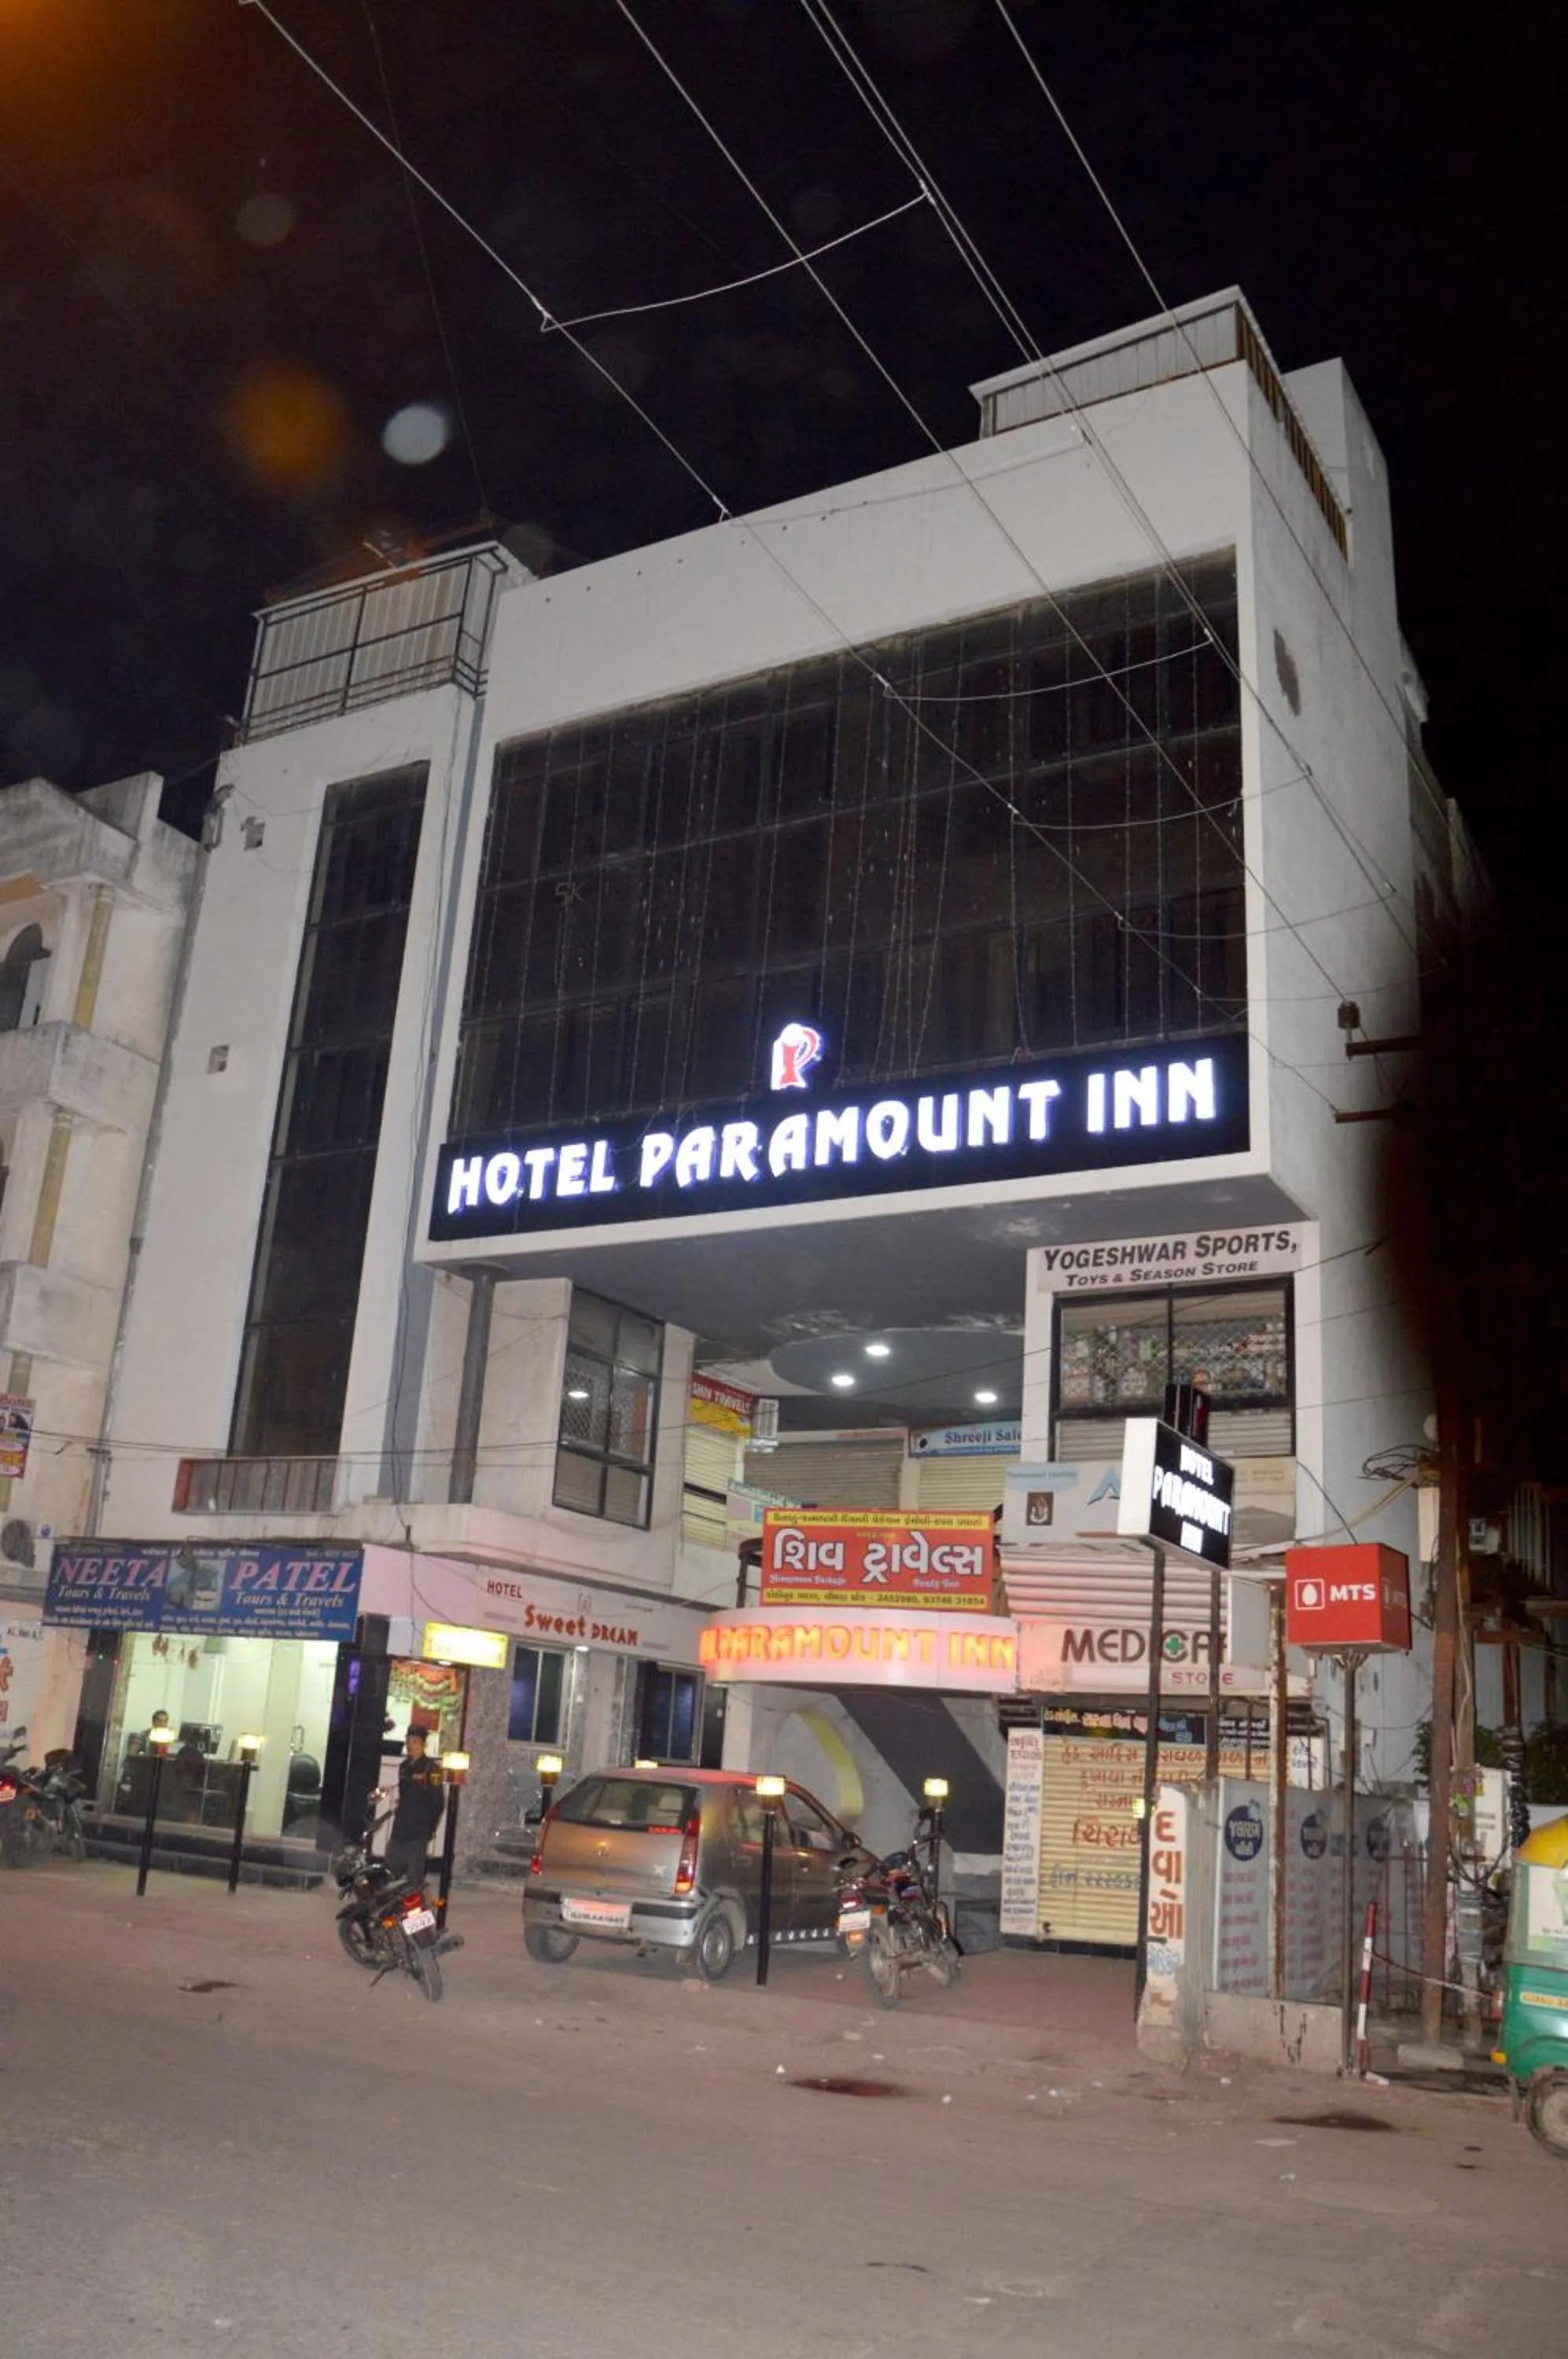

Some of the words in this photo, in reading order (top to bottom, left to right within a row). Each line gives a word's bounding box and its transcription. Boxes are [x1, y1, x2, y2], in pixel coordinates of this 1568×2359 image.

[447, 1139, 617, 1215] HOTEL
[639, 1078, 1063, 1189] PARAMOUNT
[1087, 1057, 1217, 1134] INN
[1043, 1241, 1187, 1272] YOGESHWAR
[1194, 1230, 1297, 1260] SPORTS,
[1065, 1273, 1108, 1287] TOYS
[1112, 1273, 1123, 1283] &
[1129, 1266, 1196, 1282] SEASON
[1202, 1260, 1259, 1275] STORE
[771, 1526, 845, 1572] શિવ
[860, 1529, 984, 1584] ટ્રાવેલ્સ
[52, 1557, 168, 1588] NEETA
[229, 1560, 356, 1593] PATEL
[57, 1585, 90, 1599] Tours
[109, 1587, 152, 1602] Travels
[236, 1592, 272, 1607] Tours
[277, 1593, 289, 1606] &
[295, 1593, 344, 1608] Travels
[486, 1580, 524, 1599] HOTEL
[1329, 1583, 1376, 1602] MTS
[524, 1602, 587, 1637] Sweet
[591, 1622, 639, 1647] DREAM
[719, 1625, 940, 1662] PARAMOUNT
[948, 1631, 1014, 1671] INN
[1172, 1672, 1234, 1685] STOE
